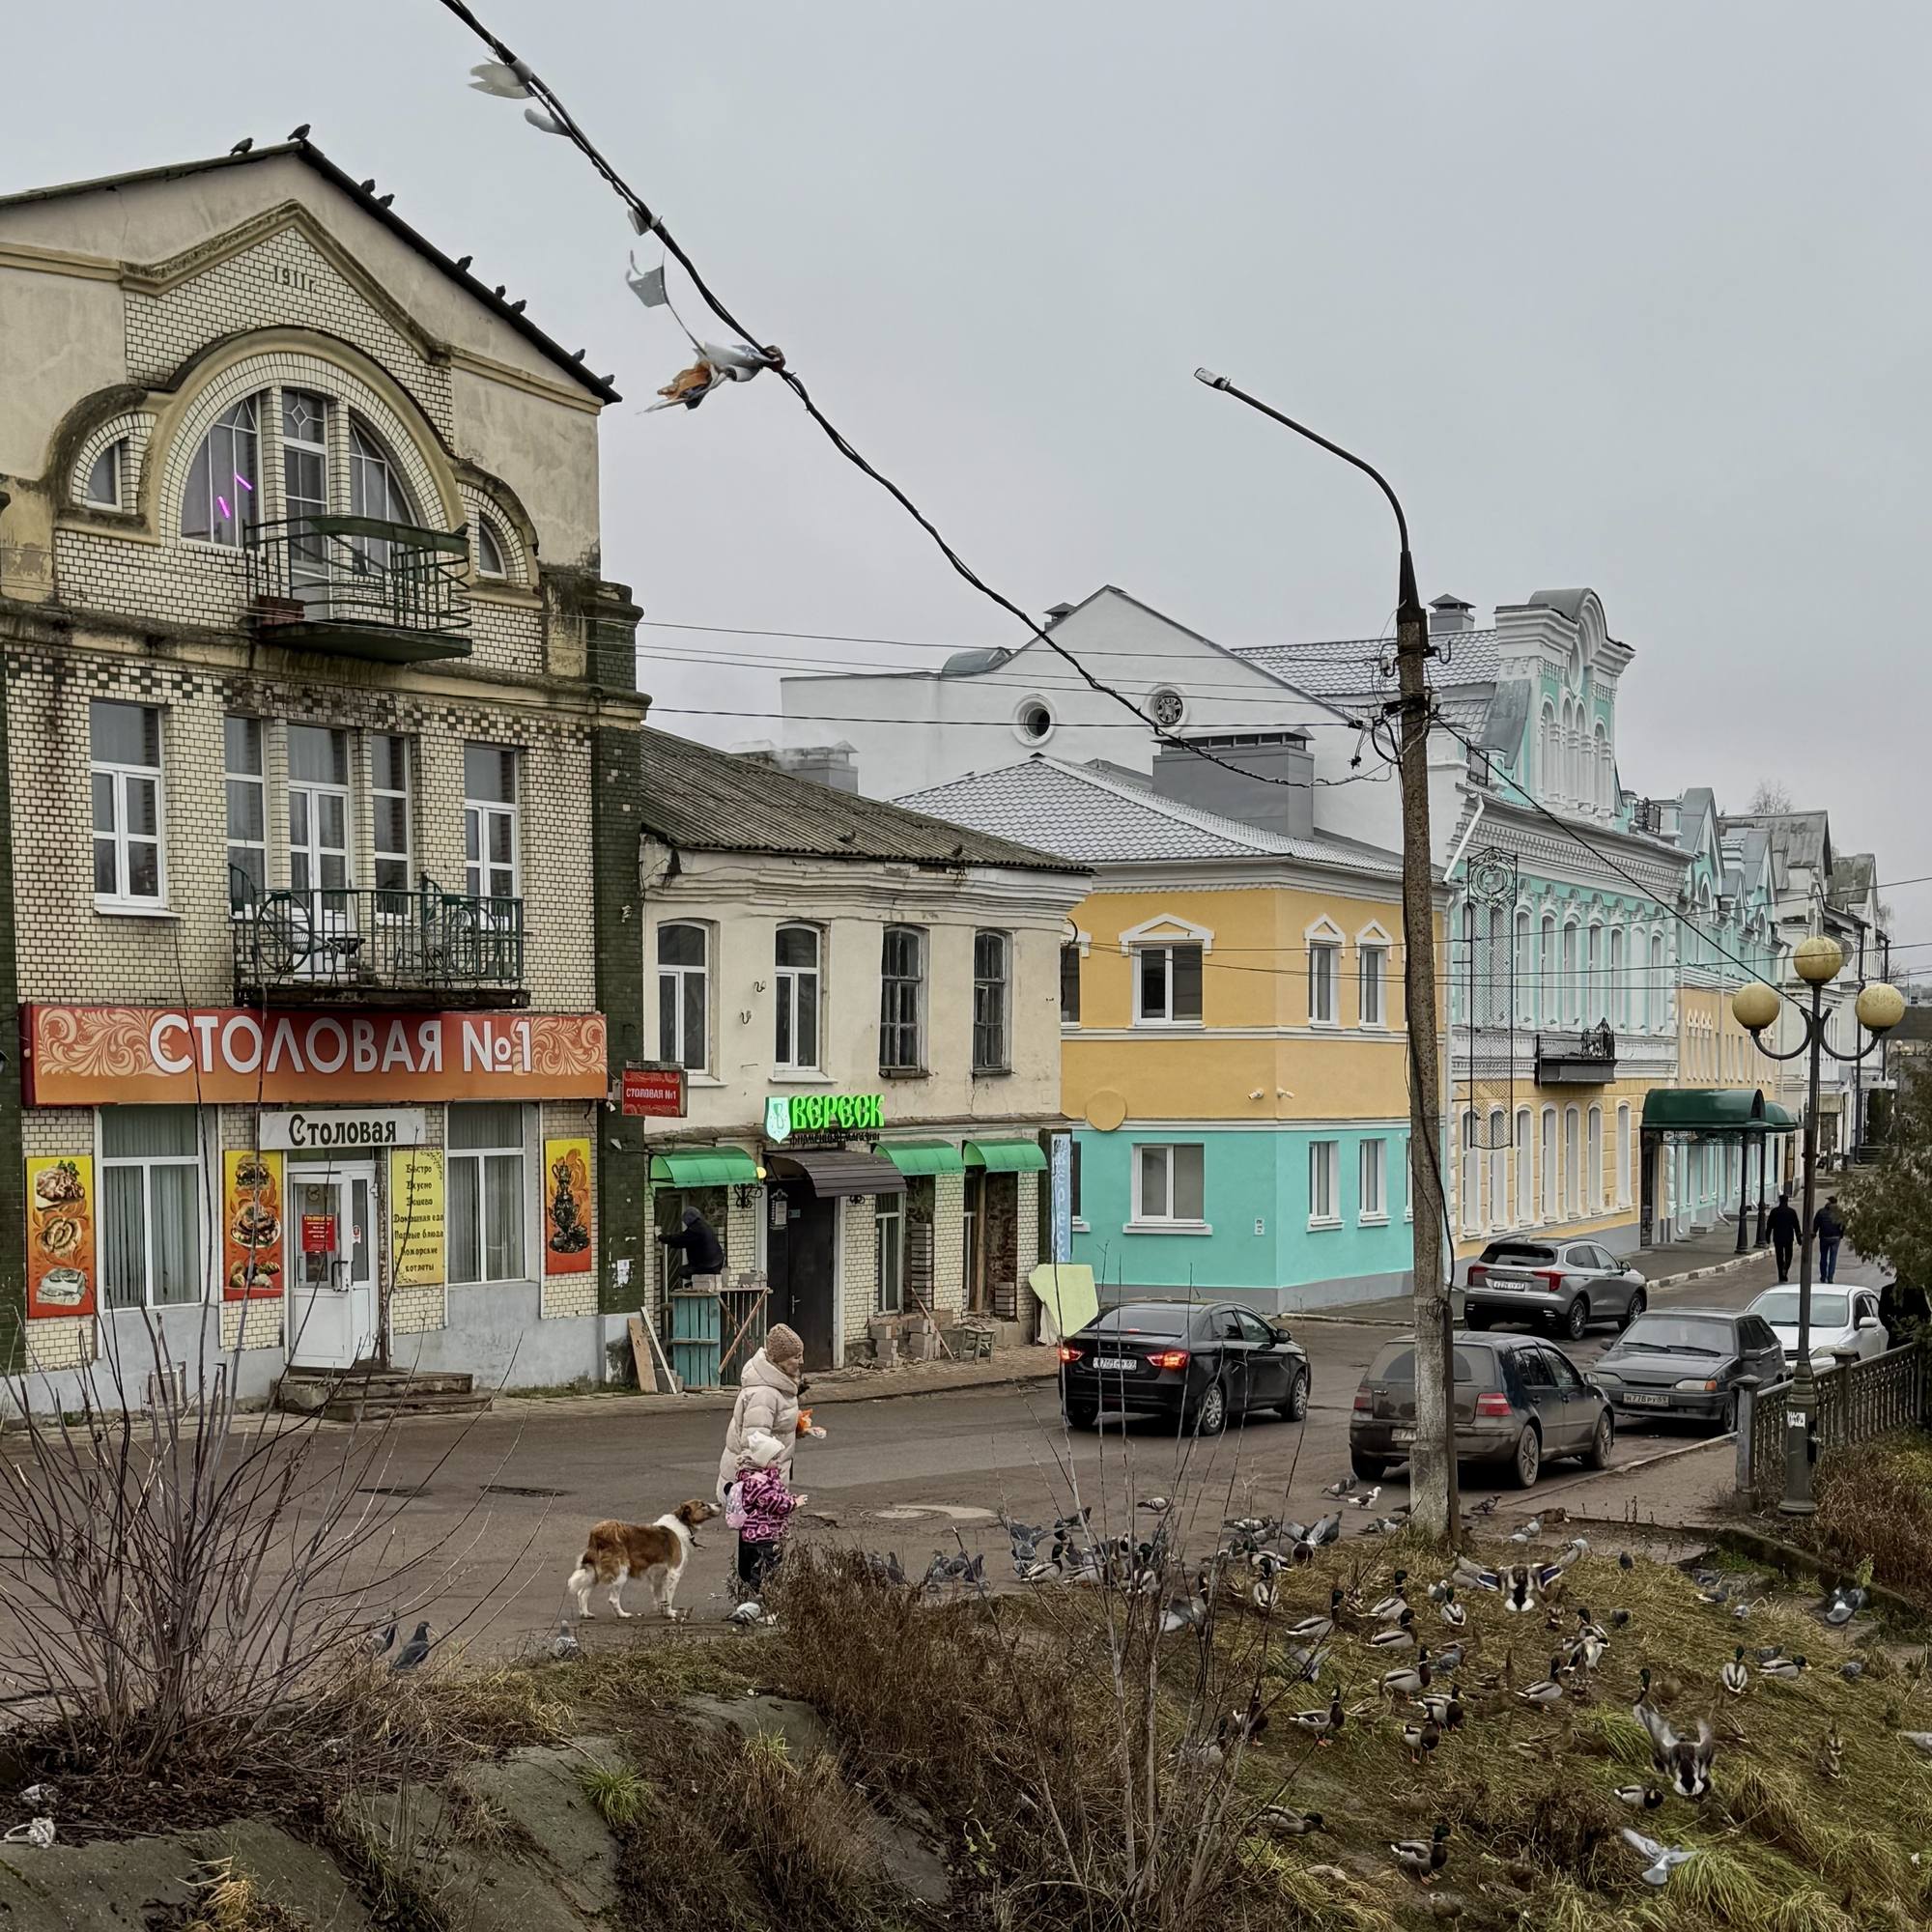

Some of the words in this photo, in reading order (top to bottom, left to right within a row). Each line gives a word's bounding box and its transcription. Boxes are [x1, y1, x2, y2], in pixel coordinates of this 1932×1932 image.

[150, 1014, 442, 1073] СТОЛОВАЯ
[463, 1020, 531, 1072] №1
[626, 1088, 664, 1099] СТОЛОВАЯ
[790, 1094, 885, 1129] ВЕРЕСК
[289, 1113, 396, 1147] Столовая
